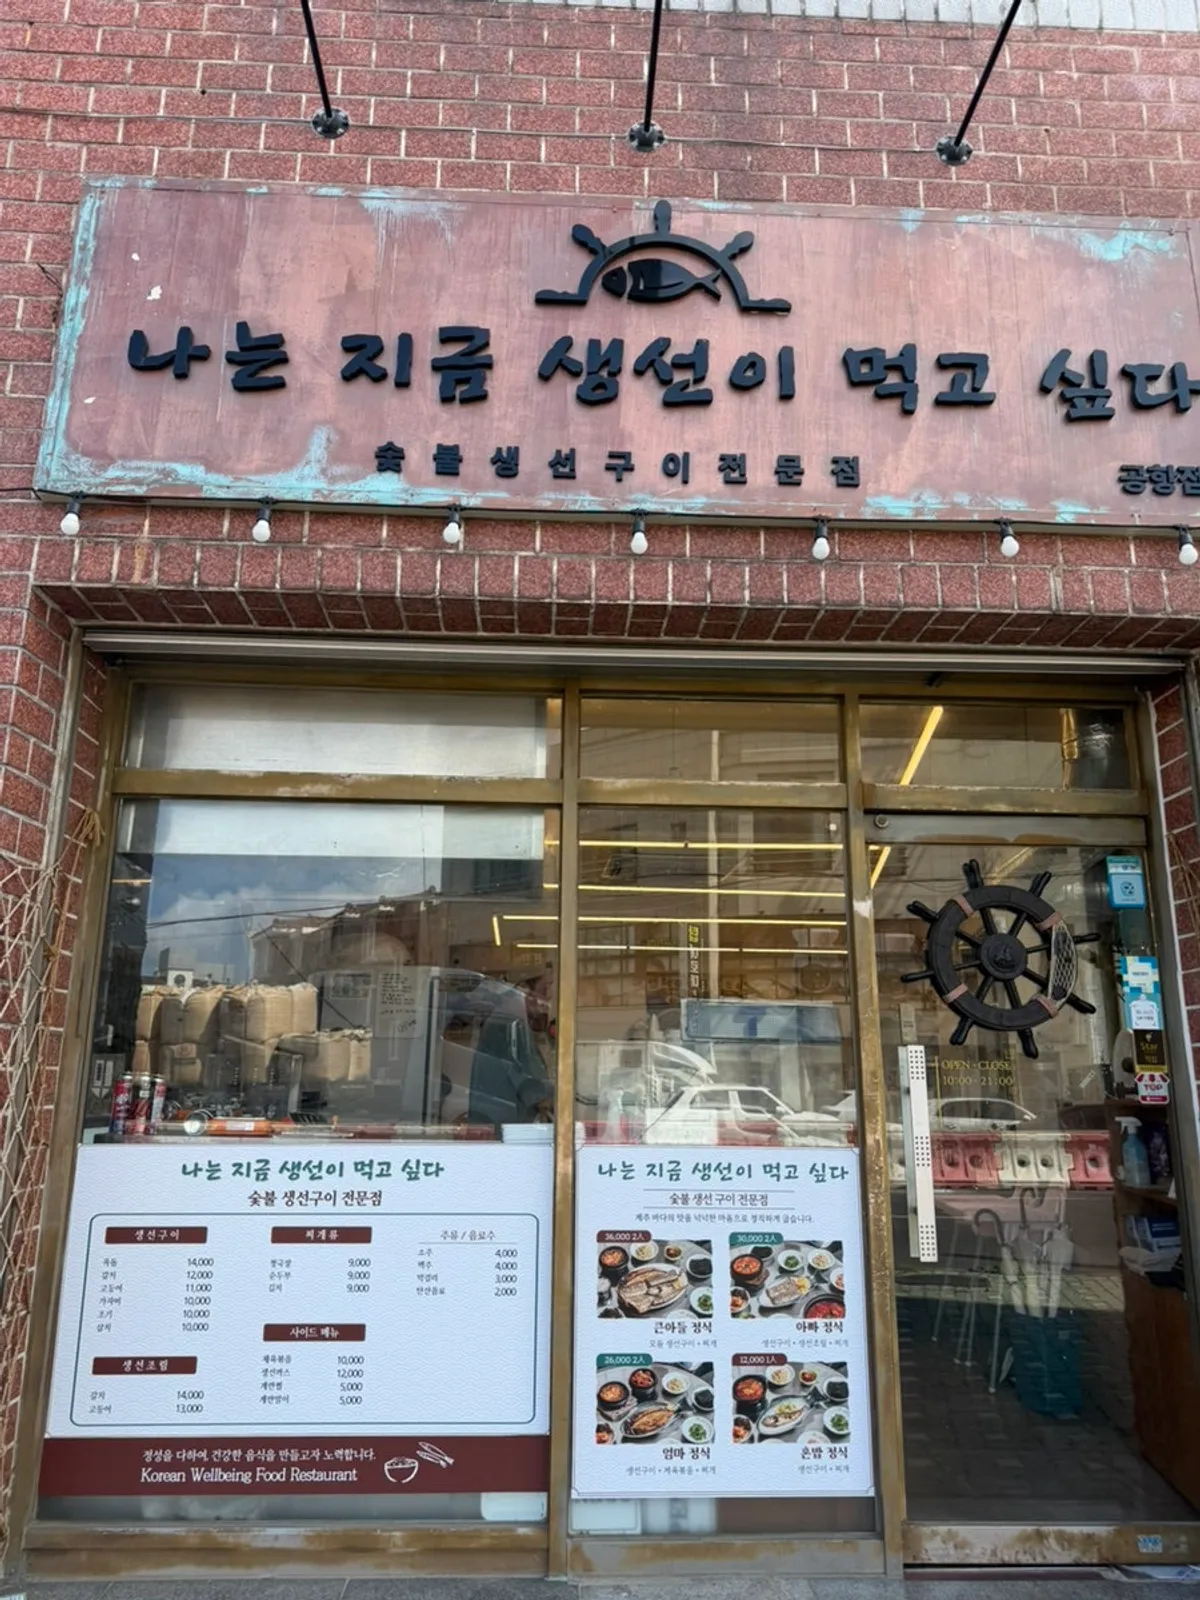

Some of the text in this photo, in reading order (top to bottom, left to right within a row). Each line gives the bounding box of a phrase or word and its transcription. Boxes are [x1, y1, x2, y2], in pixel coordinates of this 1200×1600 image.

[127, 320, 1200, 422] 나는 지금 생선이 먹고 싶다
[941, 1060, 971, 1070] OPEN
[181, 1158, 445, 1182] 나는 지금 생선이 먹고 싶다
[598, 1160, 849, 1183] 나는 지금 생선이 먹고 싶다
[248, 1190, 383, 1207] 숯불 생선구이 전문점
[669, 1192, 690, 1206] 숯불
[738, 1193, 769, 1207] 전문점
[134, 1229, 180, 1241] 생선구이
[495, 1249, 518, 1258] 4,000
[187, 1258, 214, 1267] 14,000
[348, 1258, 371, 1268] 9,000
[495, 1261, 518, 1271] 4,000
[186, 1270, 213, 1280] 12,000
[347, 1271, 371, 1281] 9,000
[185, 1283, 212, 1293] 11,000
[346, 1283, 370, 1293] 9,000
[494, 1287, 517, 1297] 2,000
[184, 1296, 211, 1306] 10,000
[183, 1309, 210, 1319] 10,000
[182, 1322, 209, 1332] 10,000
[653, 1320, 712, 1334] 큰아들 정식
[796, 1320, 844, 1334] 아빠 정식
[290, 1326, 340, 1339] 사이드 메뉴
[337, 1355, 365, 1365] 10,000
[122, 1359, 168, 1372] 생선조림
[337, 1368, 364, 1379] 12,000
[339, 1382, 363, 1392] 5,000
[177, 1390, 205, 1400] 14,000
[339, 1395, 363, 1405] 5,000
[176, 1404, 203, 1414] 13,000
[143, 1448, 173, 1462] 정성을
[211, 1448, 242, 1462] 건강한
[246, 1448, 276, 1462] 음식을
[278, 1448, 320, 1462] 만들고자
[662, 1447, 710, 1460] 엄마 정식
[801, 1446, 848, 1460] 혼밥 정식
[140, 1466, 358, 1484] Korean Wellbeing Food Restaurant
